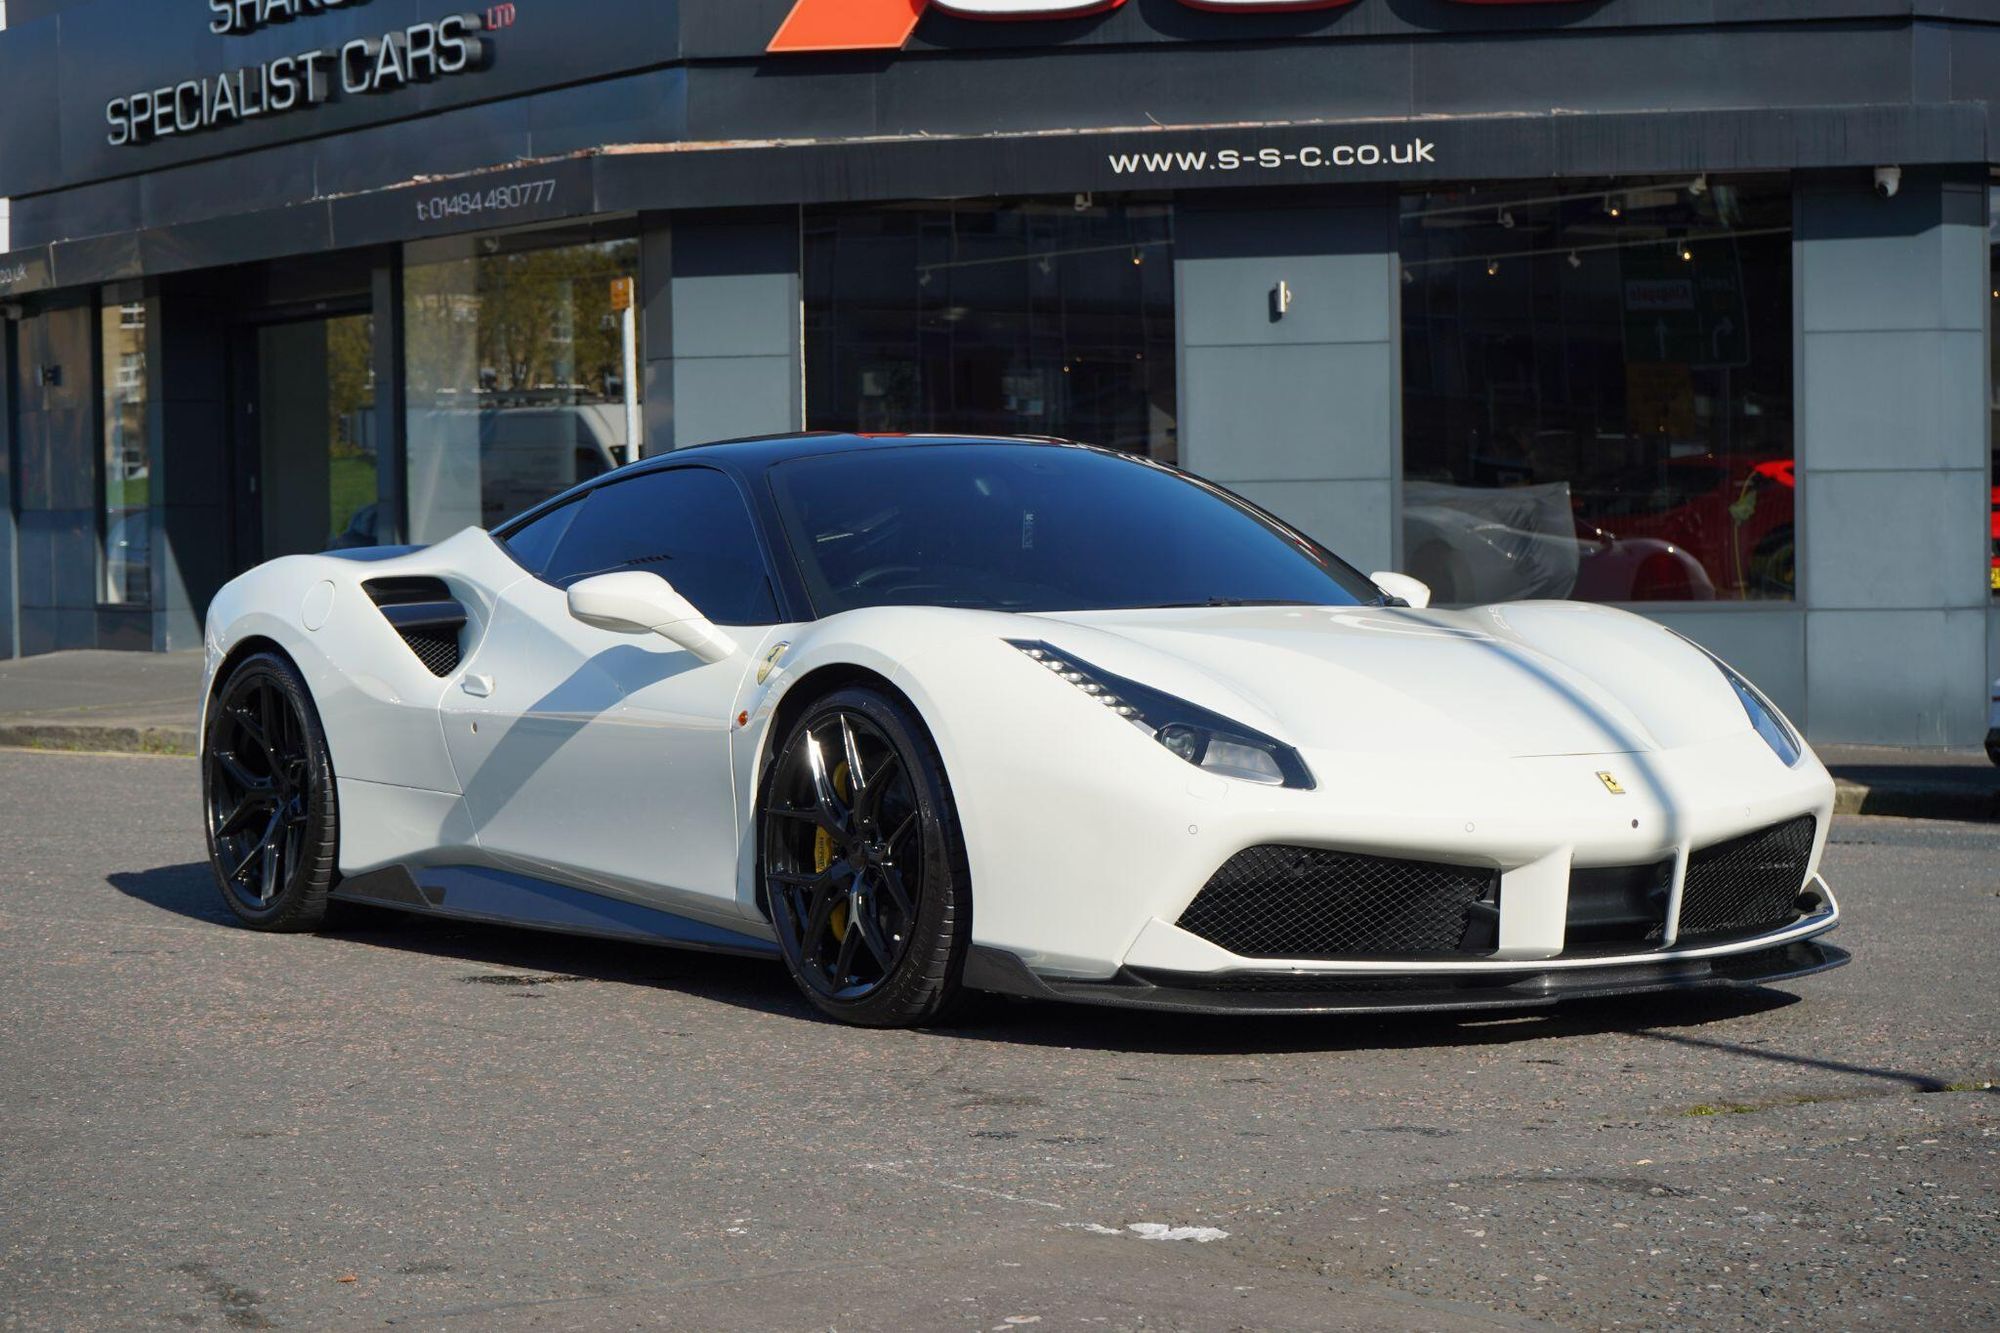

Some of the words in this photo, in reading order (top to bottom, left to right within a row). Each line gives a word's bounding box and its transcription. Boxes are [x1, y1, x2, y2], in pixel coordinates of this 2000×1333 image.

[106, 52, 319, 146] SPECIALIST
[341, 15, 467, 95] CARS
[486, 3, 516, 31] LTD
[1108, 138, 1436, 174] www.s-s-c.co.uk
